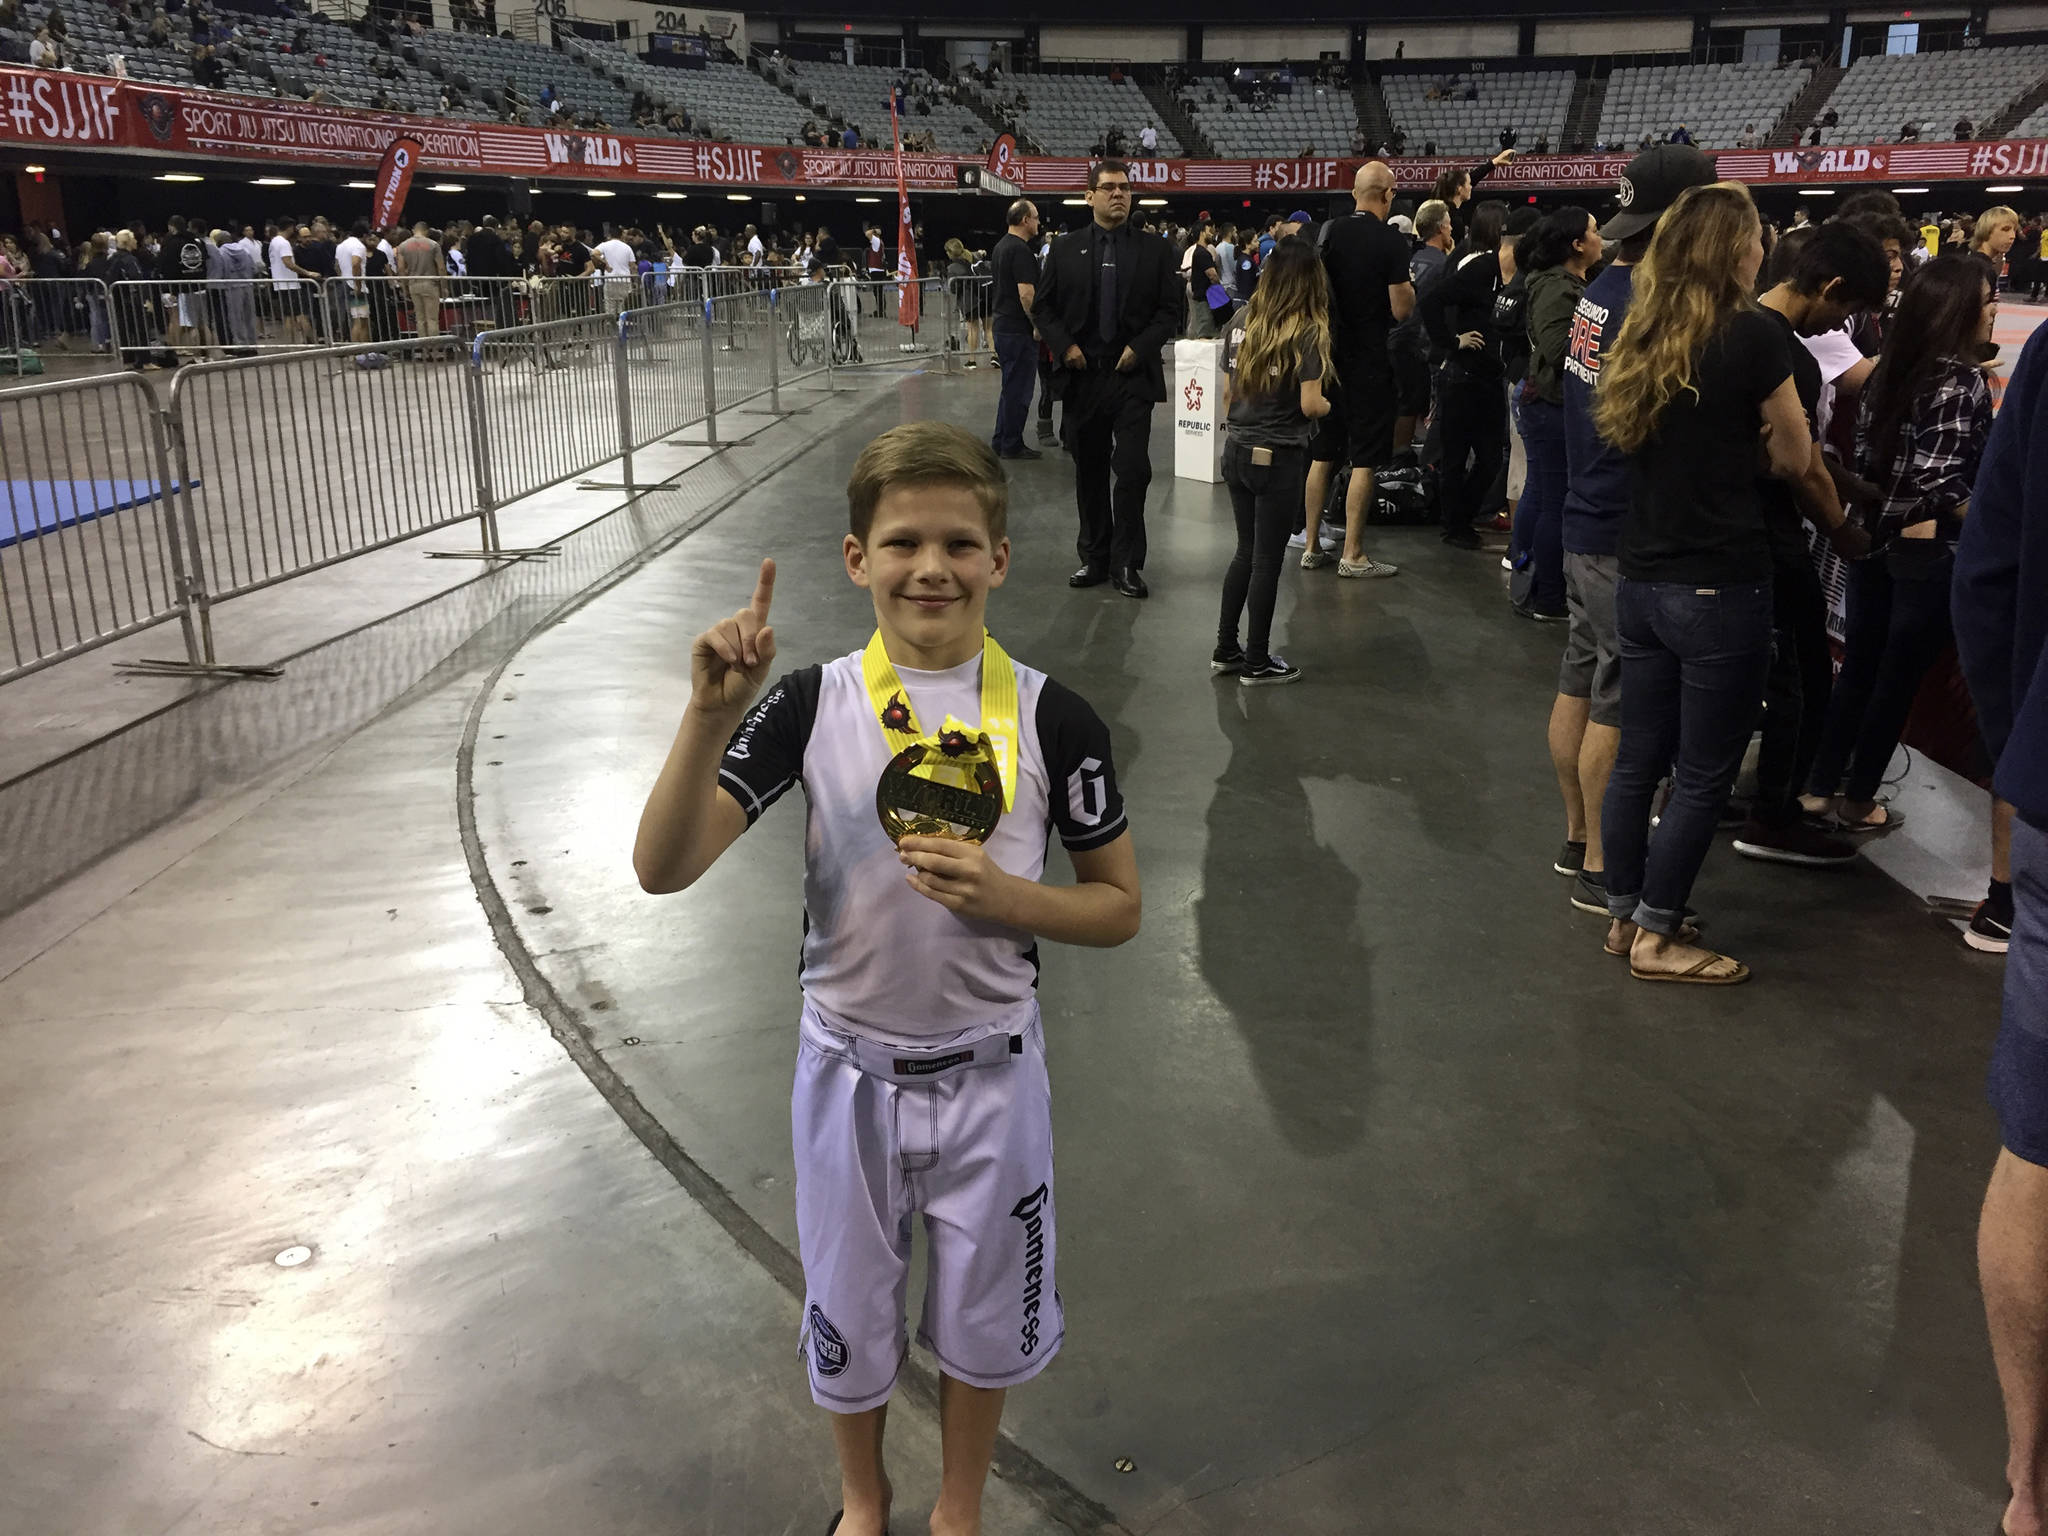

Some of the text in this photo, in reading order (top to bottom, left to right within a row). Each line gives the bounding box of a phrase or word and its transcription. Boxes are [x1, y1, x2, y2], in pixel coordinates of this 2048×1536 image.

[655, 11, 686, 30] 204
[8, 75, 119, 140] #SJJIF
[182, 107, 232, 136] SPORT
[238, 114, 257, 139] JIU
[261, 117, 296, 142] JITSU
[403, 131, 480, 157] DERATION
[544, 133, 621, 166] WRLD
[1772, 149, 1870, 173] WRLD
[696, 146, 763, 181] #SJJIF
[803, 160, 836, 175] SPORT
[840, 160, 852, 176] JIU
[854, 161, 877, 176] JITSU
[1255, 162, 1337, 189] #SJJIF
[1494, 164, 1598, 179] INTERNATIONAL
[1578, 297, 1609, 325] SEGUNDO
[1178, 420, 1211, 431] REPUBLIC
[1009, 1181, 1049, 1357] Gameness
